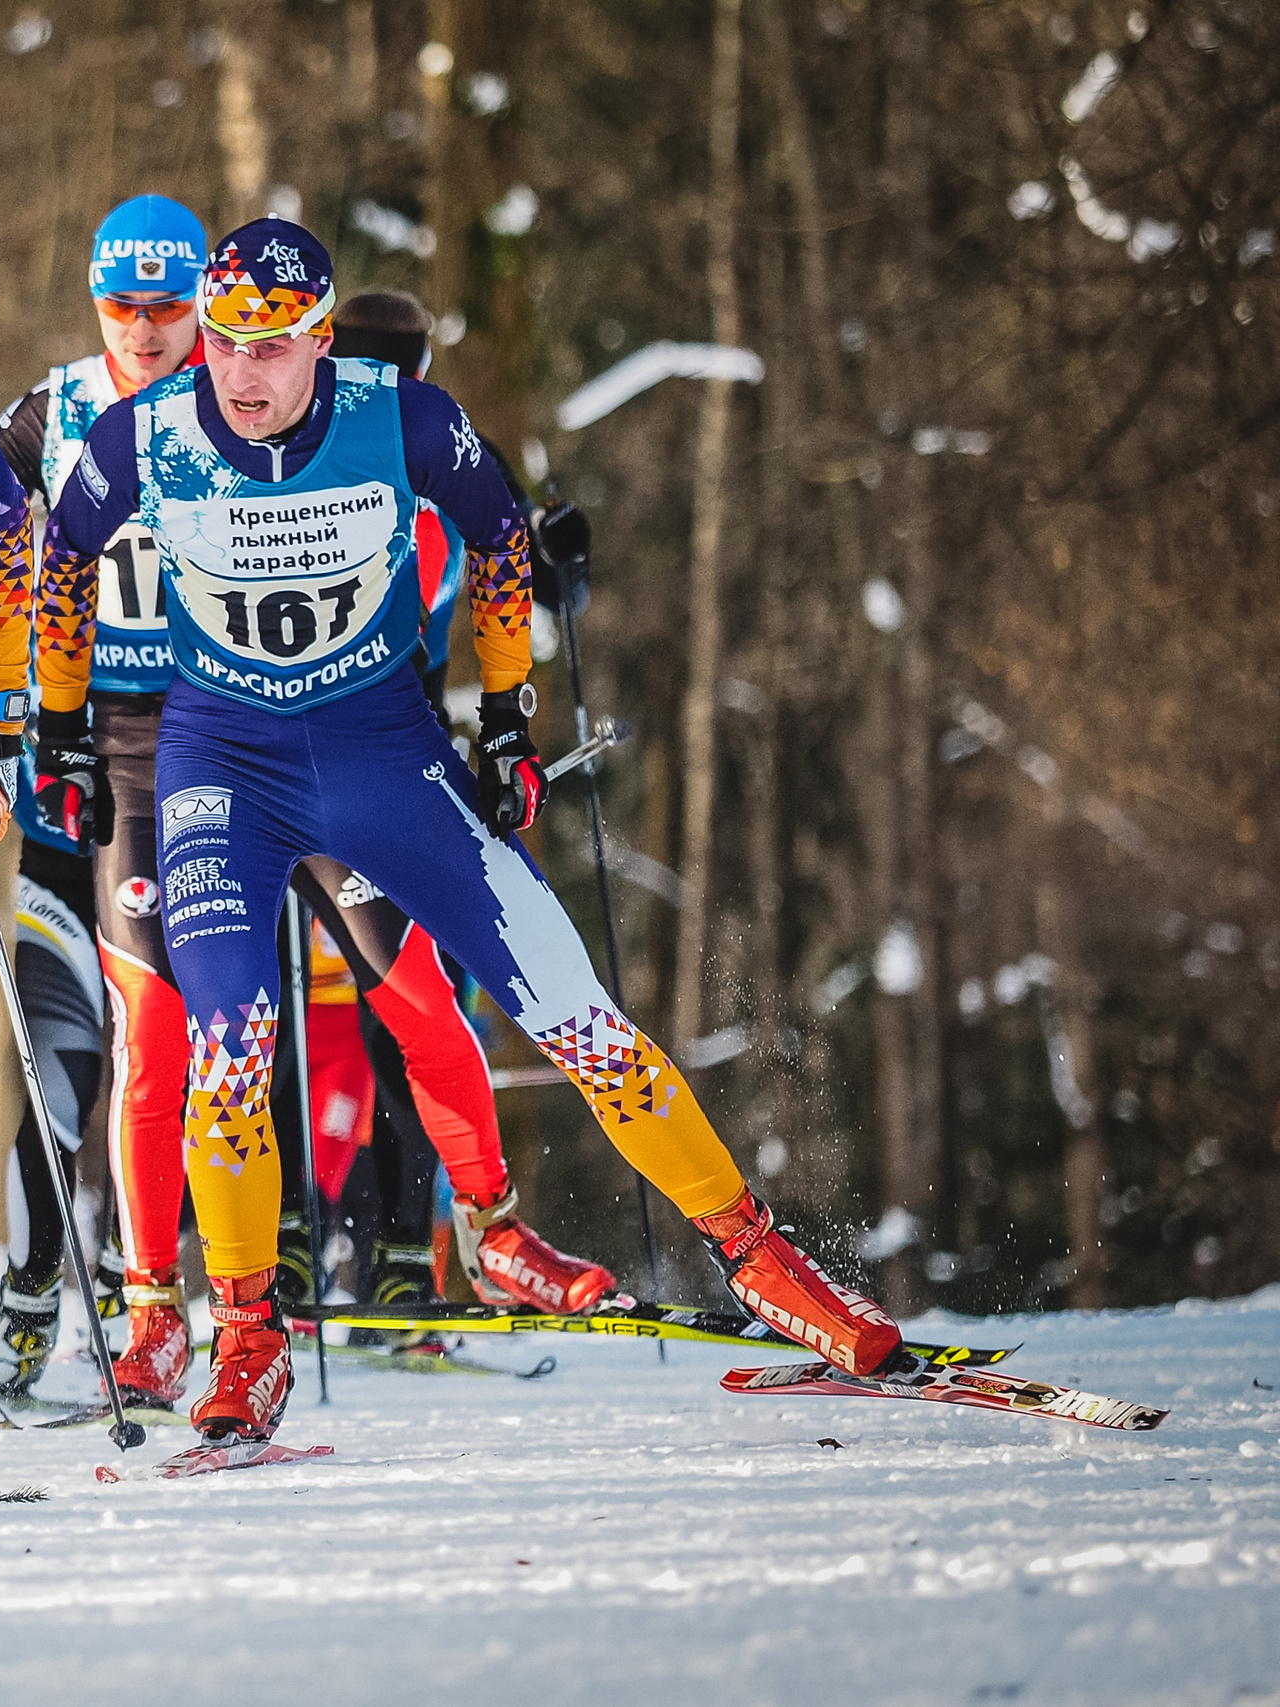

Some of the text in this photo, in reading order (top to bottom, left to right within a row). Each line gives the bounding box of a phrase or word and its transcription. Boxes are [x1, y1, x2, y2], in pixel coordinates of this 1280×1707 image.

[100, 240, 197, 260] LUKOIL
[229, 489, 384, 530] Крещенский
[231, 521, 339, 548] лыжный
[101, 537, 169, 619] 17
[233, 549, 346, 573] марафон
[206, 575, 363, 658] 167
[95, 644, 174, 668] КРАСН
[195, 633, 391, 700] КРАСНОГОРСК
[167, 879, 243, 910] NUTRITION
[190, 924, 252, 940] PELOTON
[475, 1249, 565, 1308] pina
[511, 1319, 661, 1337] FISCHER
[729, 1276, 856, 1374] alpina
[1040, 1389, 1160, 1430] ATOMIC
